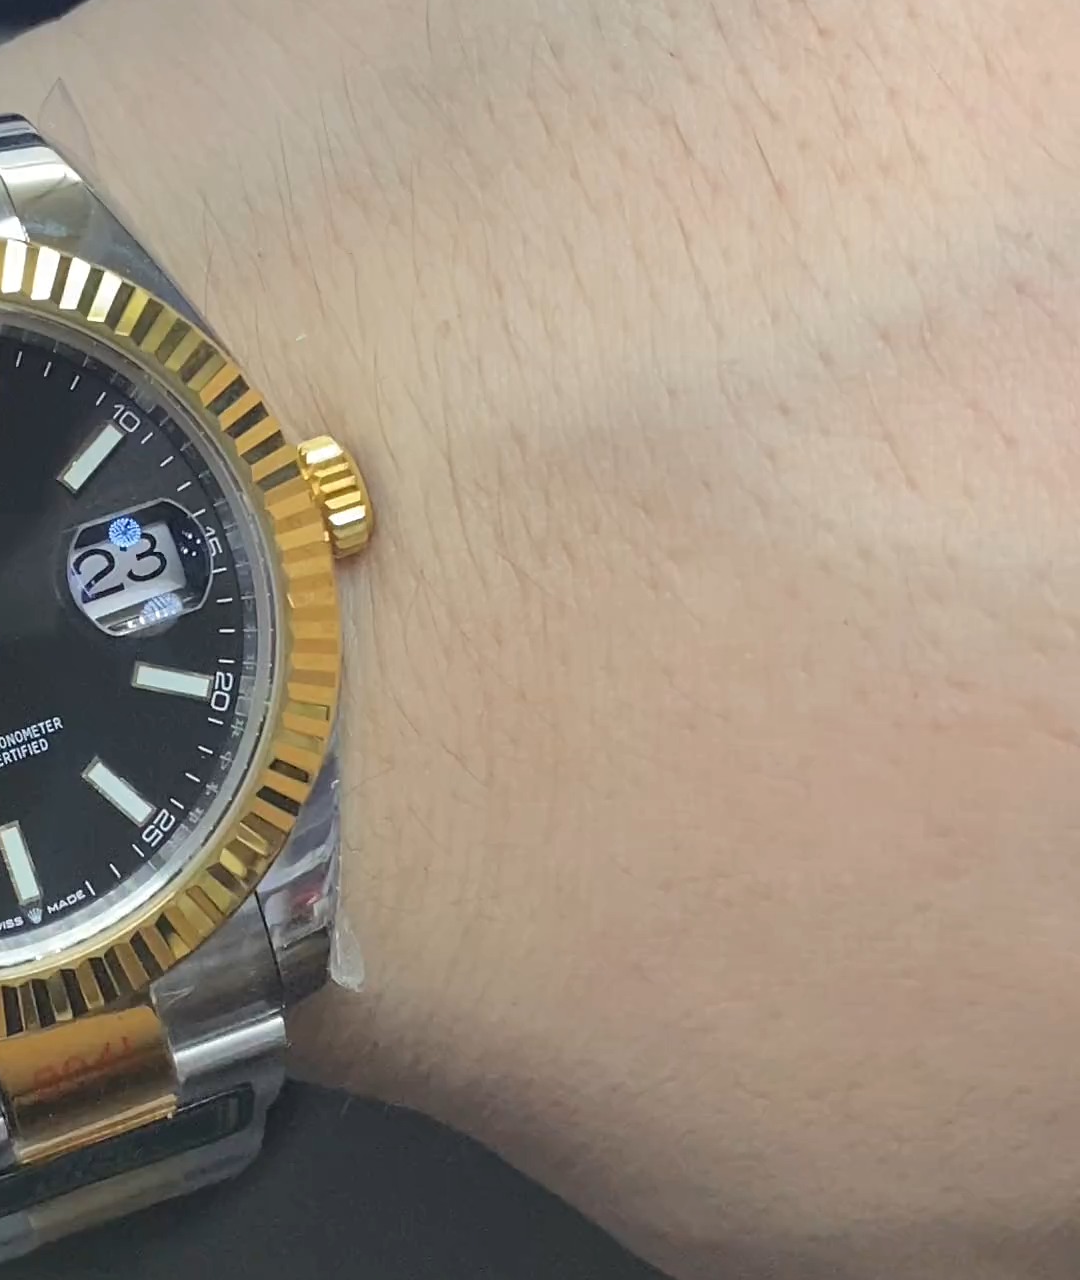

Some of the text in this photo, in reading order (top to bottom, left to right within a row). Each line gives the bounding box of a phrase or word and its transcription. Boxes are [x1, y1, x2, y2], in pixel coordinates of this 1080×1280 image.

[113, 404, 140, 433] 10
[73, 531, 168, 605] 23
[210, 671, 234, 712] 20
[141, 808, 176, 847] 25
[46, 889, 87, 915] MADE
